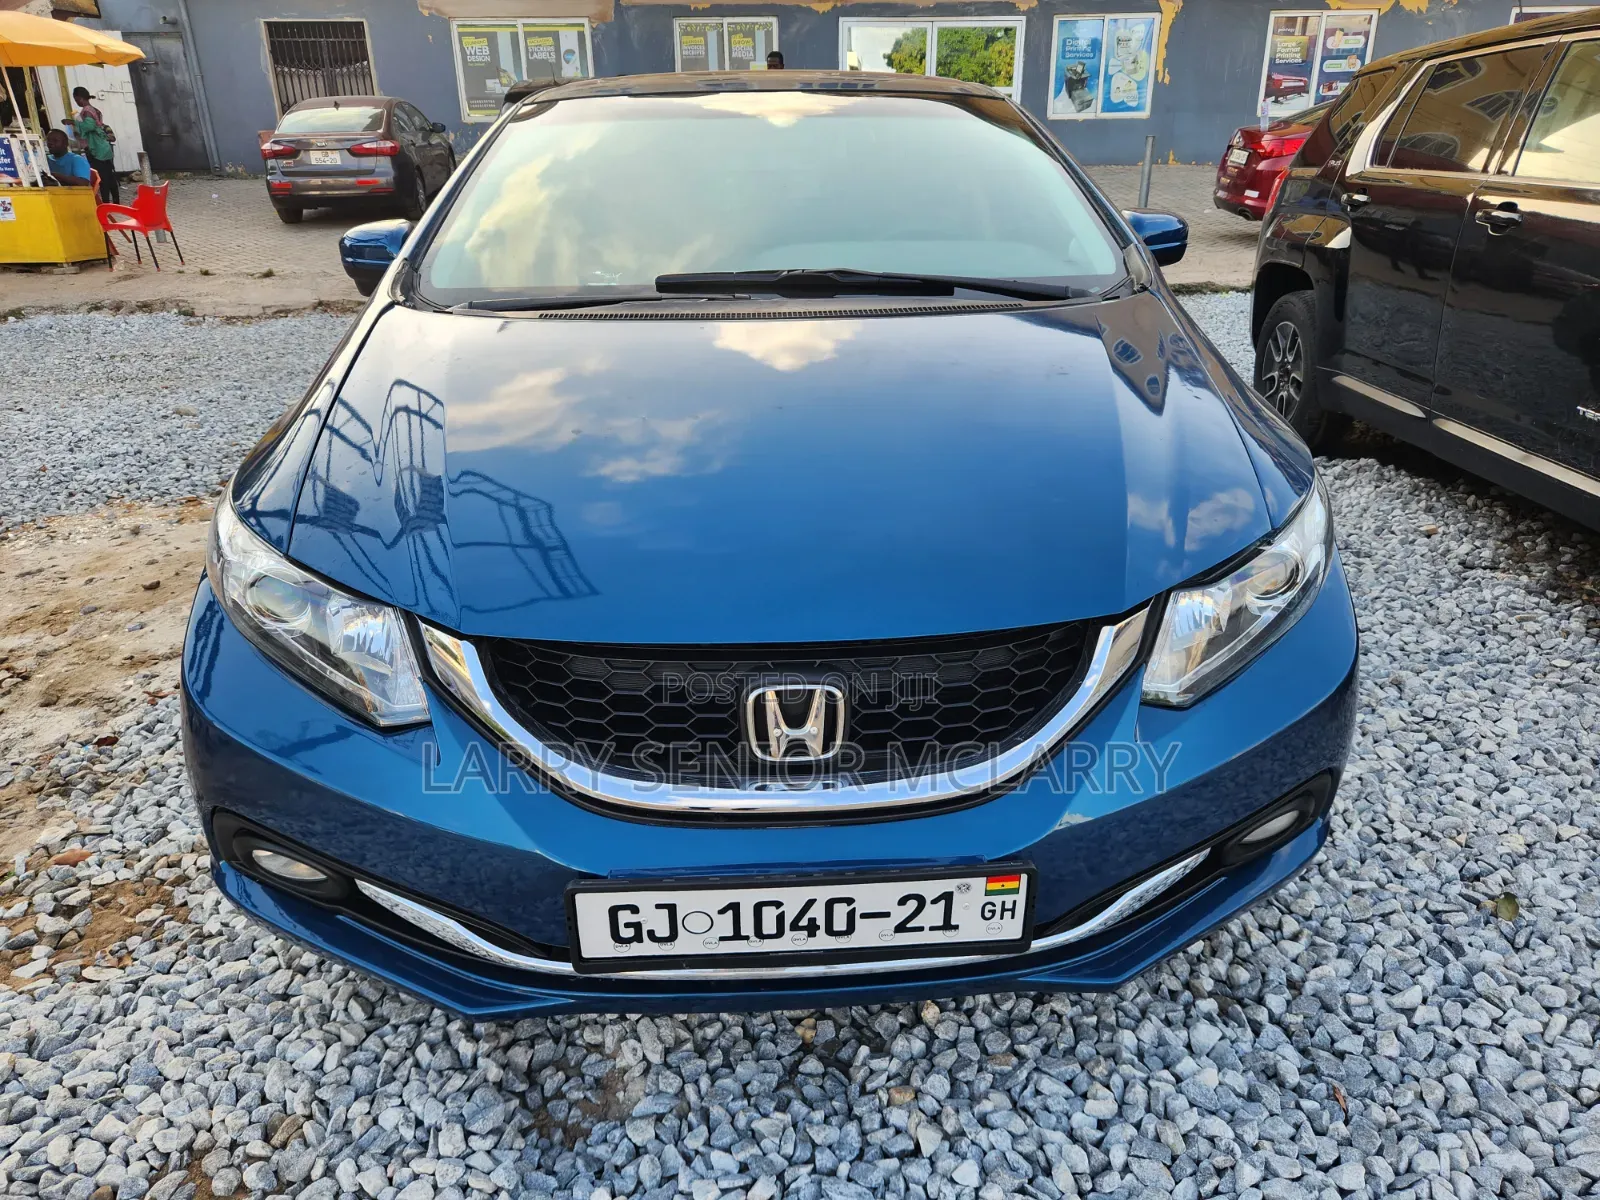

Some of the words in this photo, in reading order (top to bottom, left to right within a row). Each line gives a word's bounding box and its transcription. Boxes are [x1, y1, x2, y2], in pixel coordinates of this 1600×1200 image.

[1066, 38, 1091, 46] Digital
[465, 46, 490, 55] WEB
[607, 902, 679, 945] GJ
[716, 890, 960, 942] 1040-21
[981, 900, 1017, 921] GH
